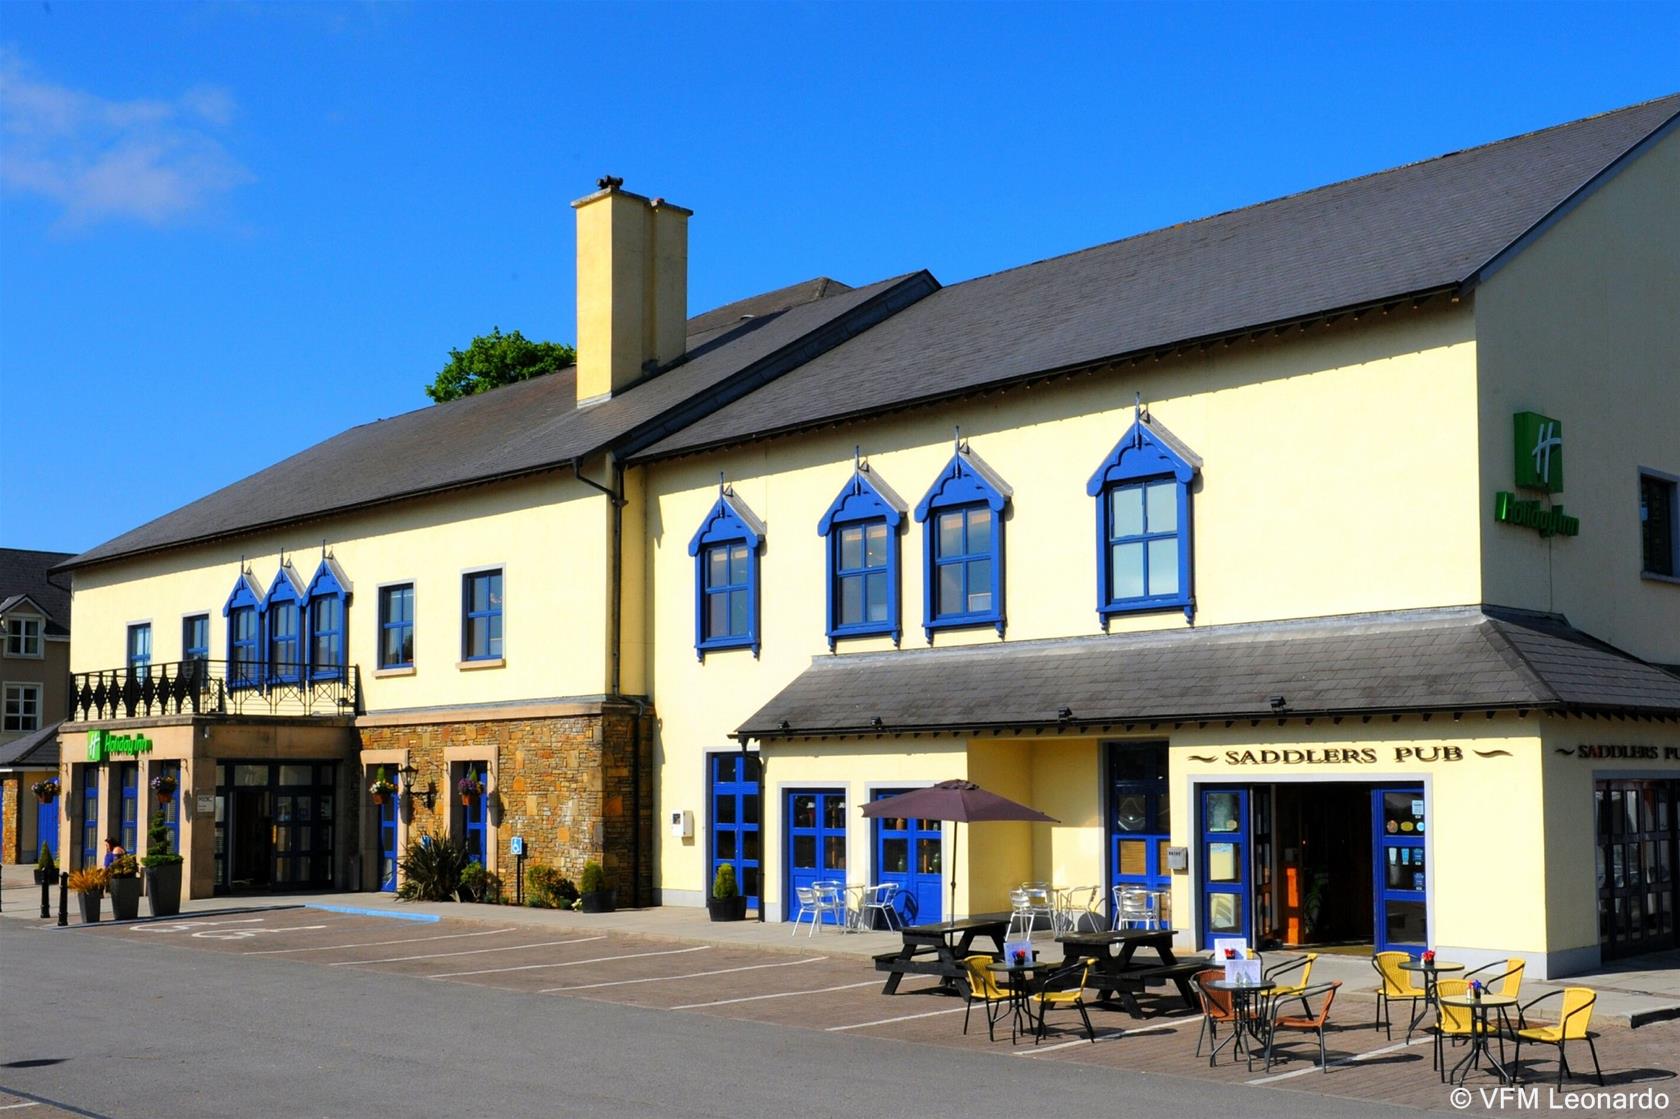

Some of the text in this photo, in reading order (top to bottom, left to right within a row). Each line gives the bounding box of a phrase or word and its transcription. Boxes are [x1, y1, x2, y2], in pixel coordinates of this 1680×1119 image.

[104, 734, 149, 756] Holiday Inn
[1225, 745, 1464, 765] SADDLERS PUB
[1577, 744, 1658, 759] SADDLERS
